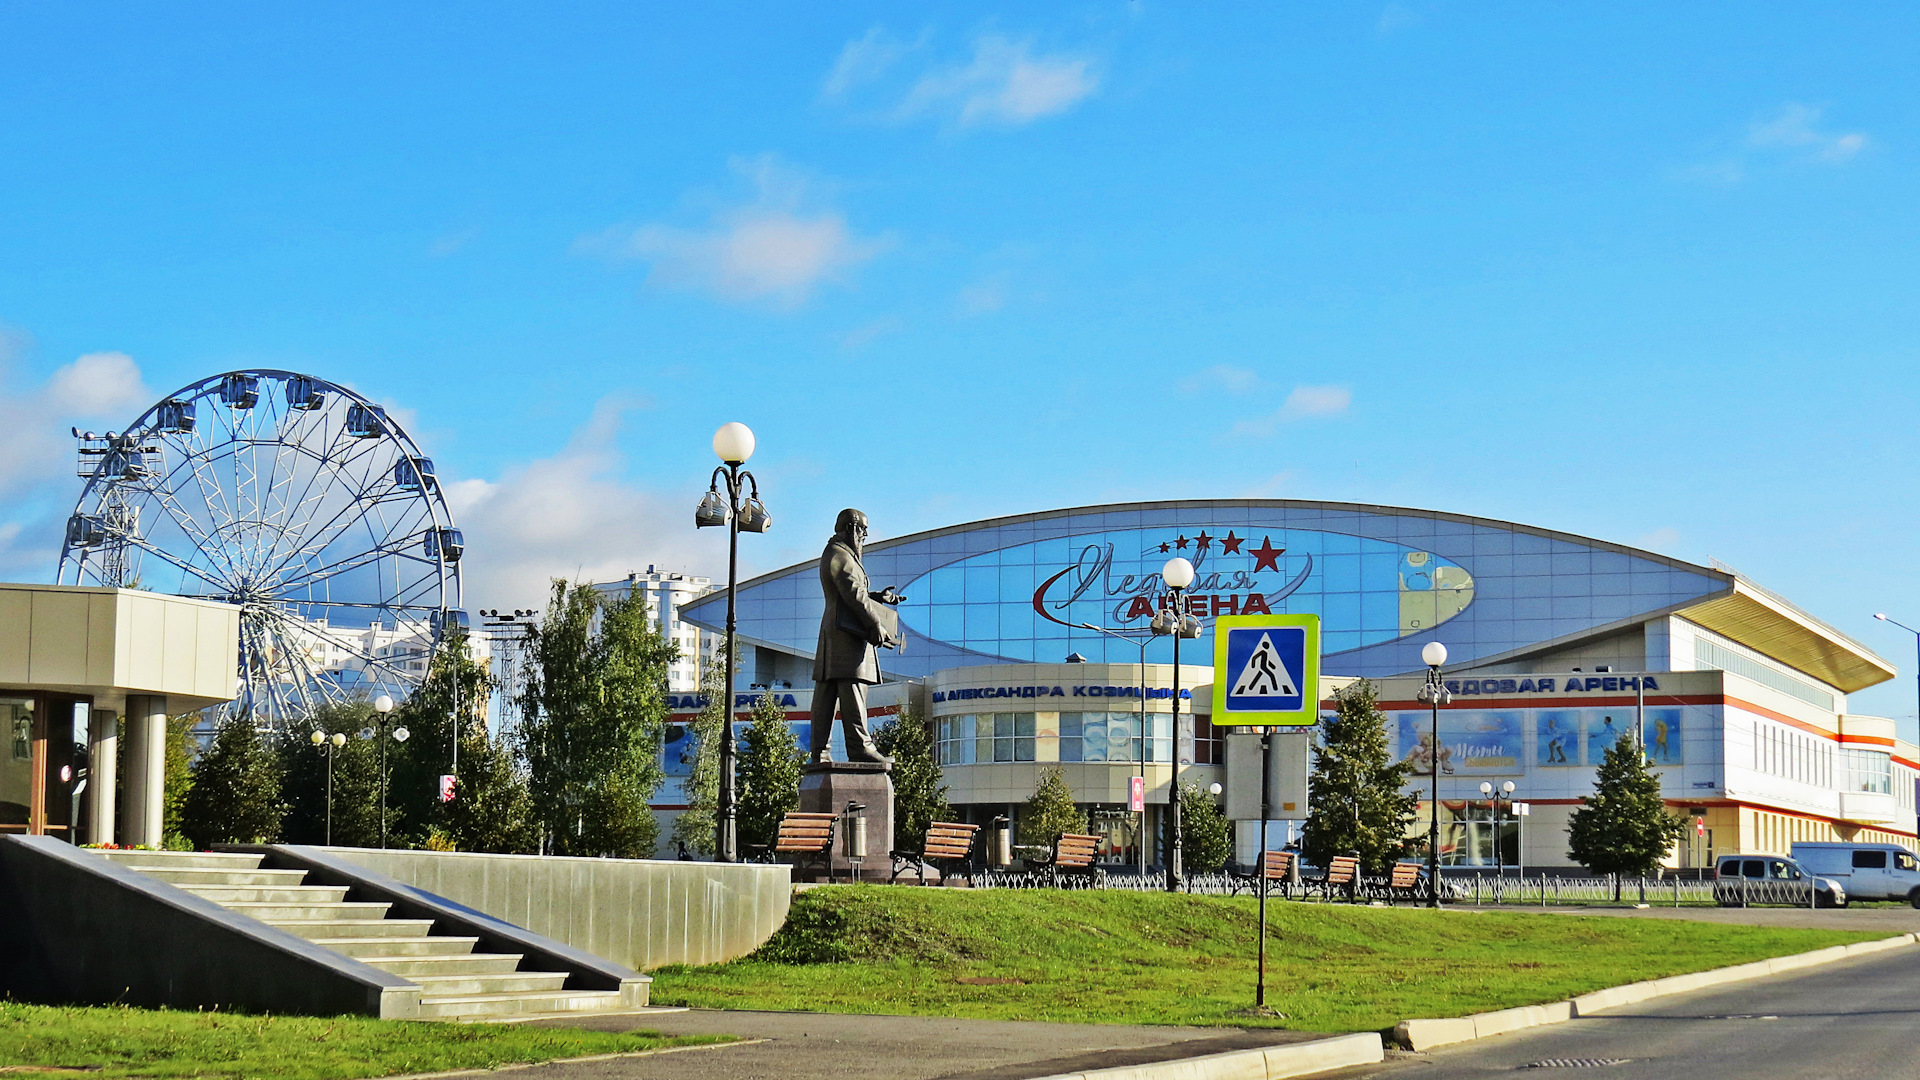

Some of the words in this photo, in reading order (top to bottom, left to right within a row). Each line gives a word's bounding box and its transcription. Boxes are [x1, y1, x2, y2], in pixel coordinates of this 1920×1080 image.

[1055, 542, 1258, 624] Ледвая
[947, 685, 1066, 701] АЛЕКСАНДРА
[1444, 678, 1555, 695] ЕДОВАЯ
[1564, 676, 1660, 692] АРЕНА
